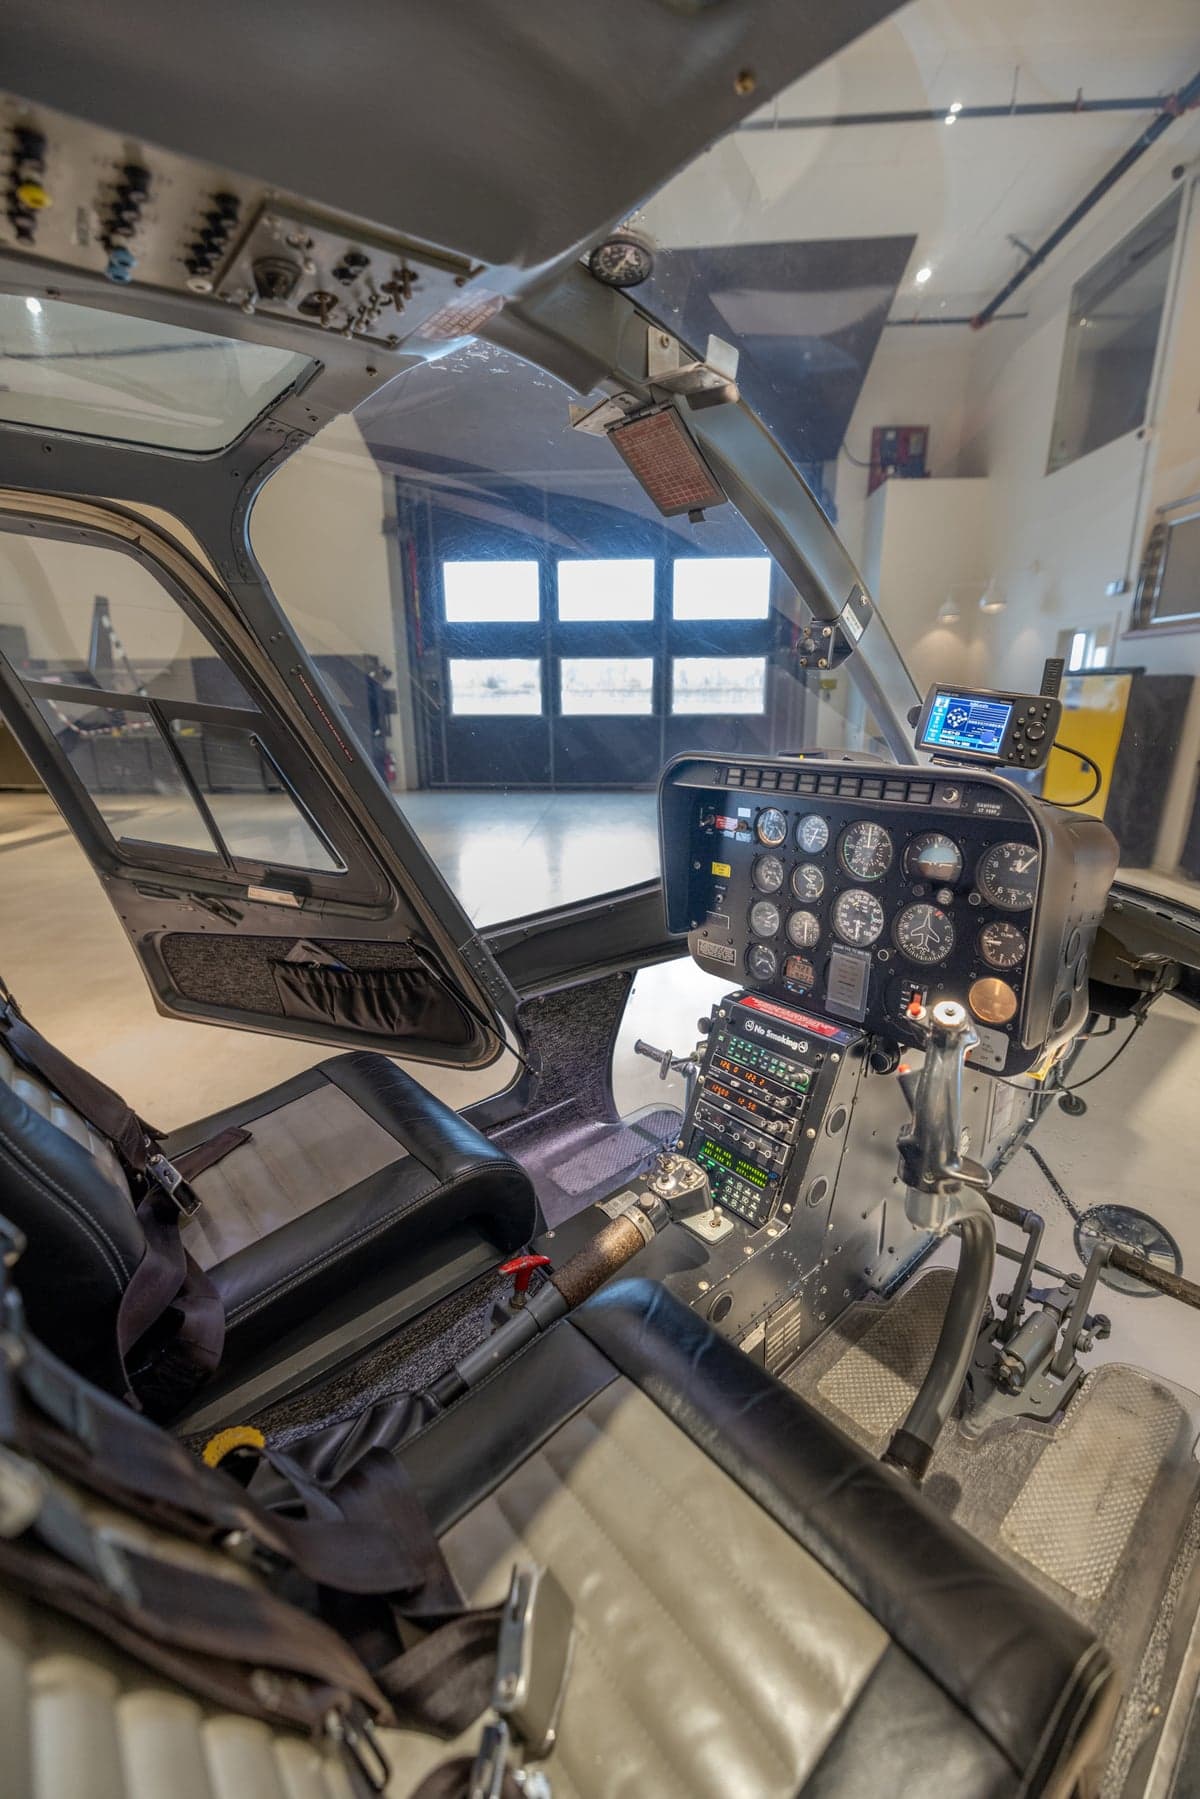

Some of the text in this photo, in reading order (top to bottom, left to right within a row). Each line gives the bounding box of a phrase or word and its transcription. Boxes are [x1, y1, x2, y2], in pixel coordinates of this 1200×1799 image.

[1019, 849, 1025, 857] 0
[997, 886, 1004, 894] 6
[753, 1024, 799, 1051] No Smoking
